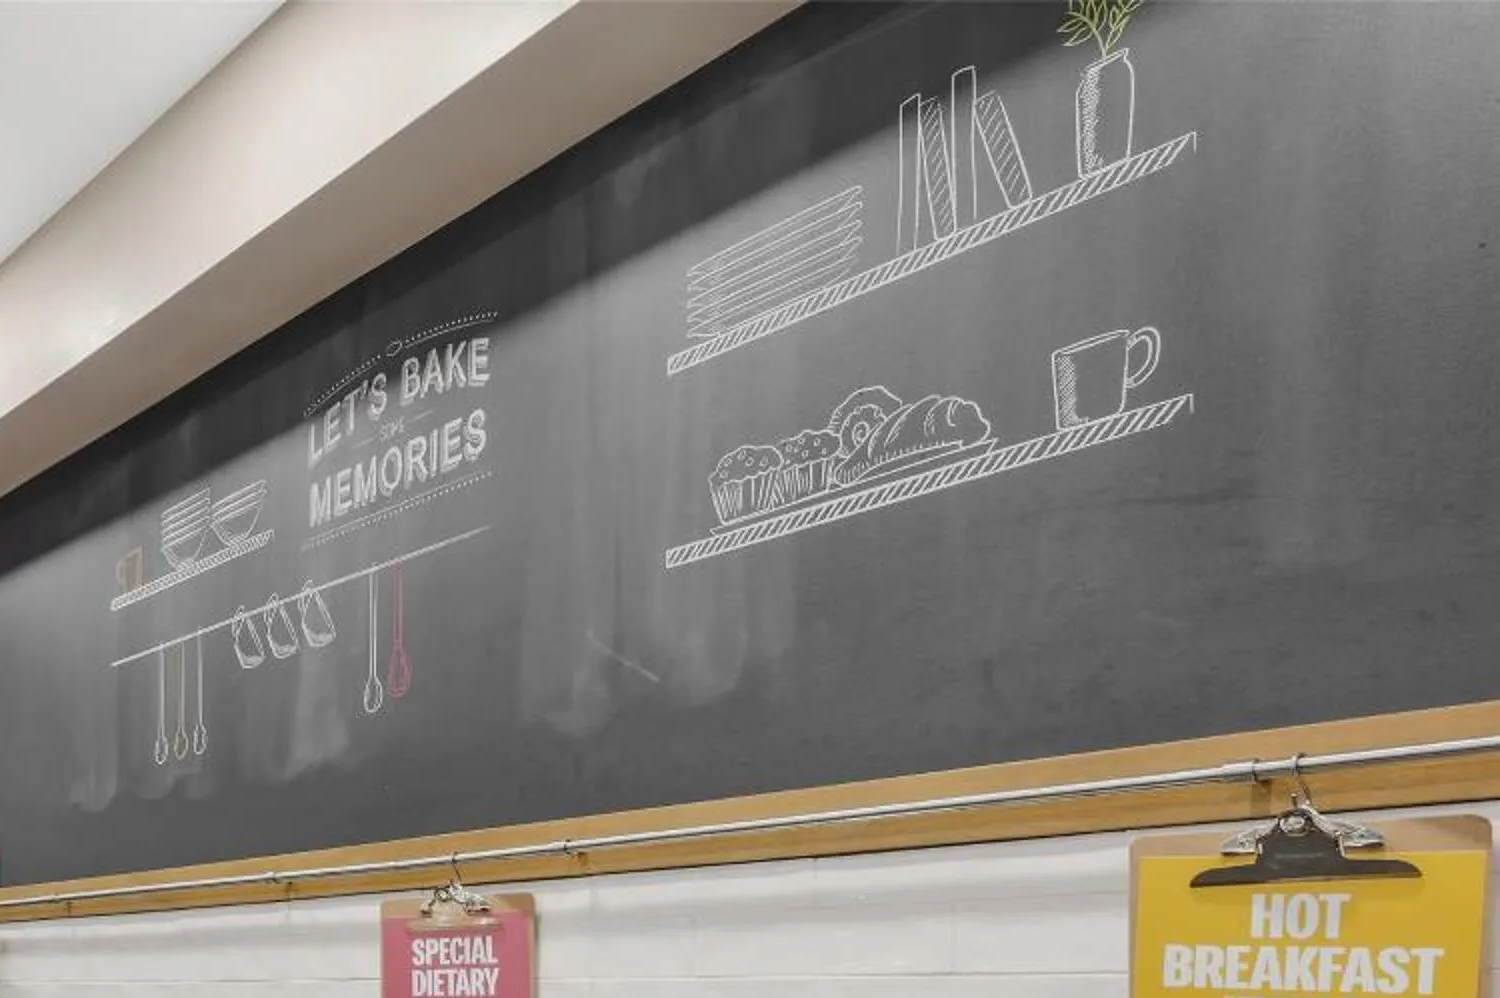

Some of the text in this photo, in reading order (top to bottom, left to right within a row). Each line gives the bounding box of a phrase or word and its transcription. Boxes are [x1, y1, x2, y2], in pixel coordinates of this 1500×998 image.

[308, 337, 491, 468] LET'S BAKE
[309, 408, 487, 528] MEMORIES
[1250, 892, 1352, 939] HOT
[411, 935, 499, 966] SPECIAL
[1162, 943, 1445, 995] BREAKFAST
[411, 967, 500, 997] DIETARY
